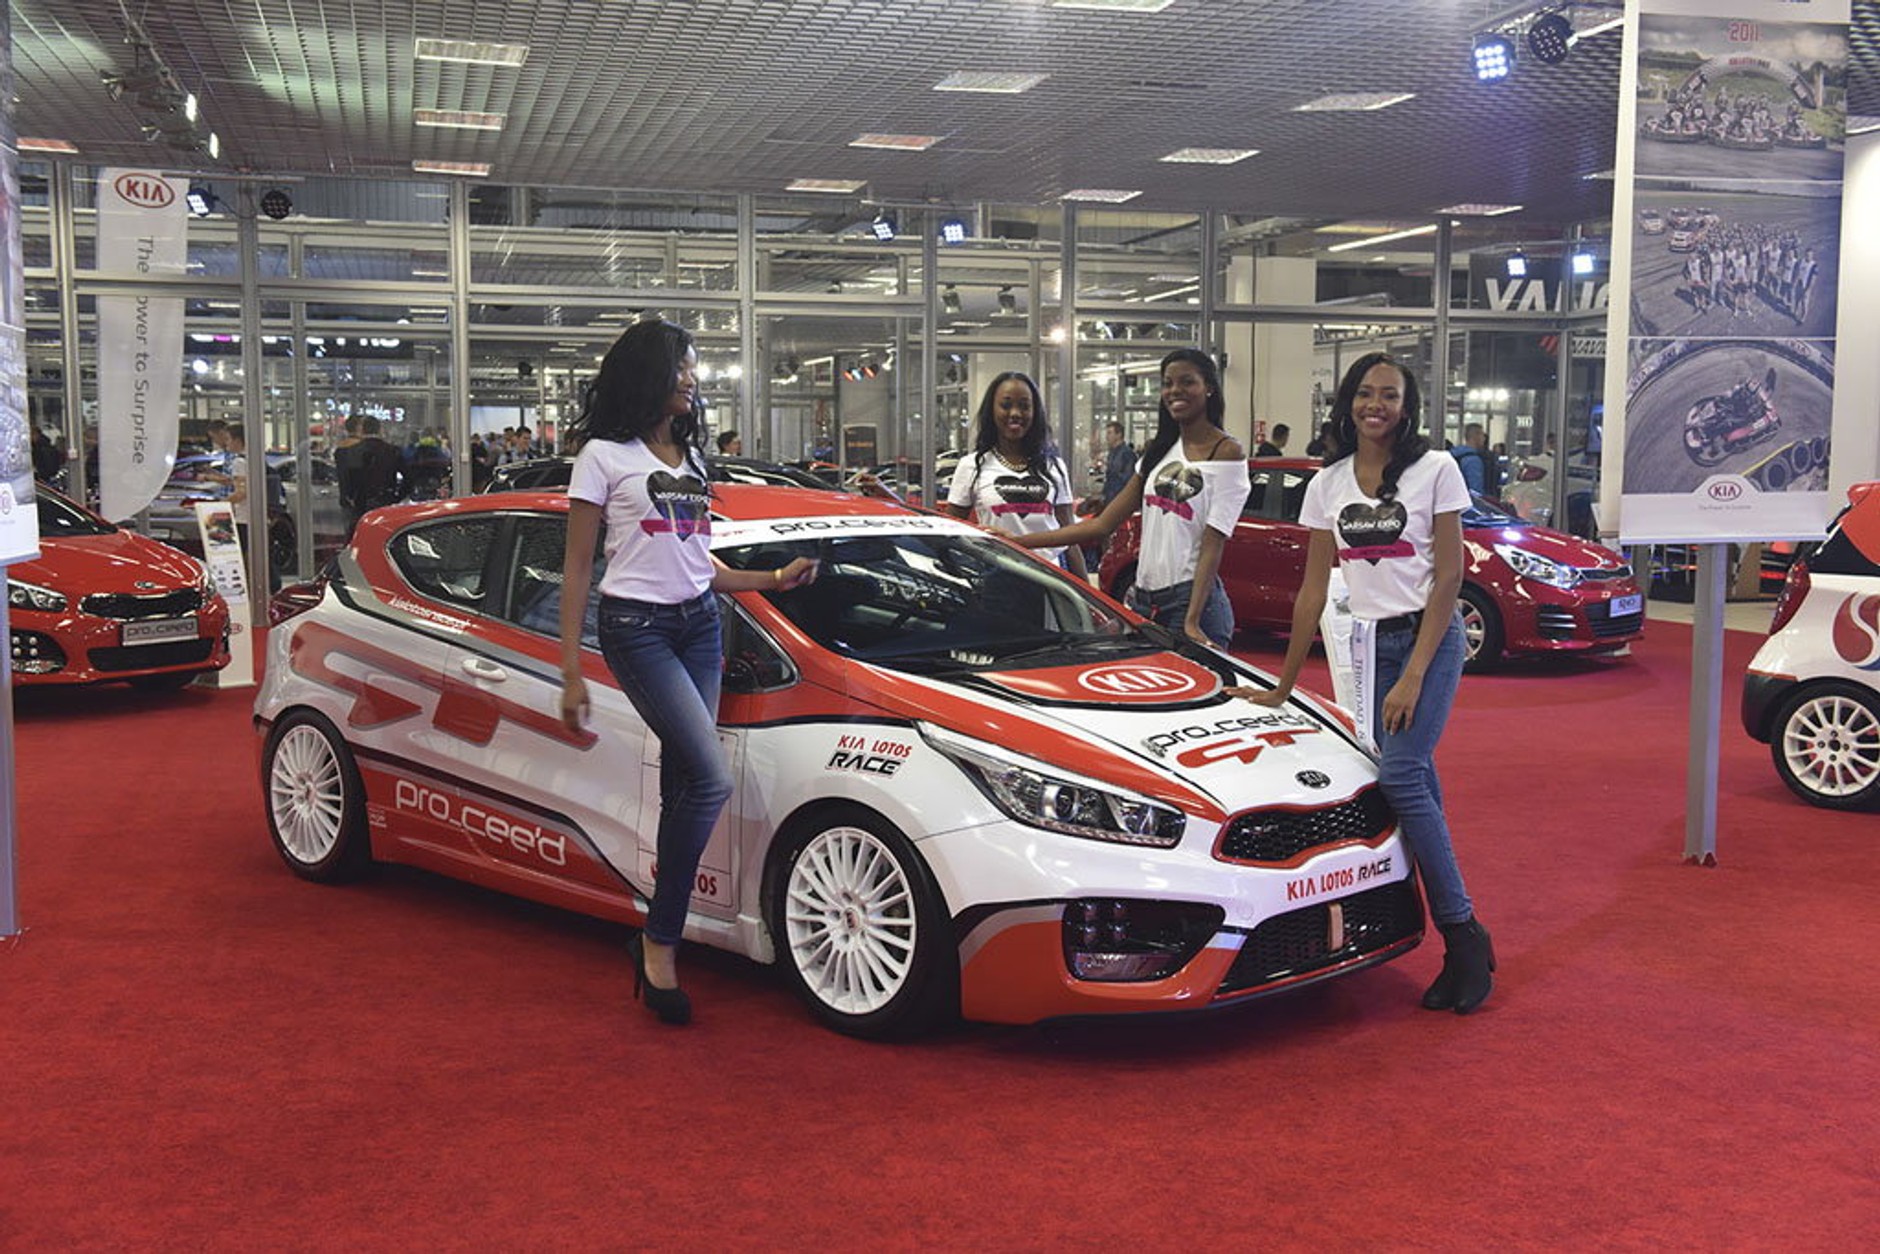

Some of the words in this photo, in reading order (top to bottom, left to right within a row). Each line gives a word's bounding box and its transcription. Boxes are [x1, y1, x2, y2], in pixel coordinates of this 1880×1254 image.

[1728, 22, 1759, 42] 2011
[126, 178, 165, 203] KIA
[136, 235, 154, 274] The
[135, 294, 150, 346] ower
[135, 351, 150, 373] to
[131, 378, 150, 464] Surprise
[1713, 485, 1738, 498] KIA
[1090, 669, 1185, 693] KIA
[837, 734, 866, 751] KIA
[871, 740, 913, 759] LOTOS
[828, 751, 902, 776] RACE
[1286, 877, 1316, 901] KIA
[1320, 867, 1354, 893] LOTOS
[1357, 857, 1392, 881] RACE
